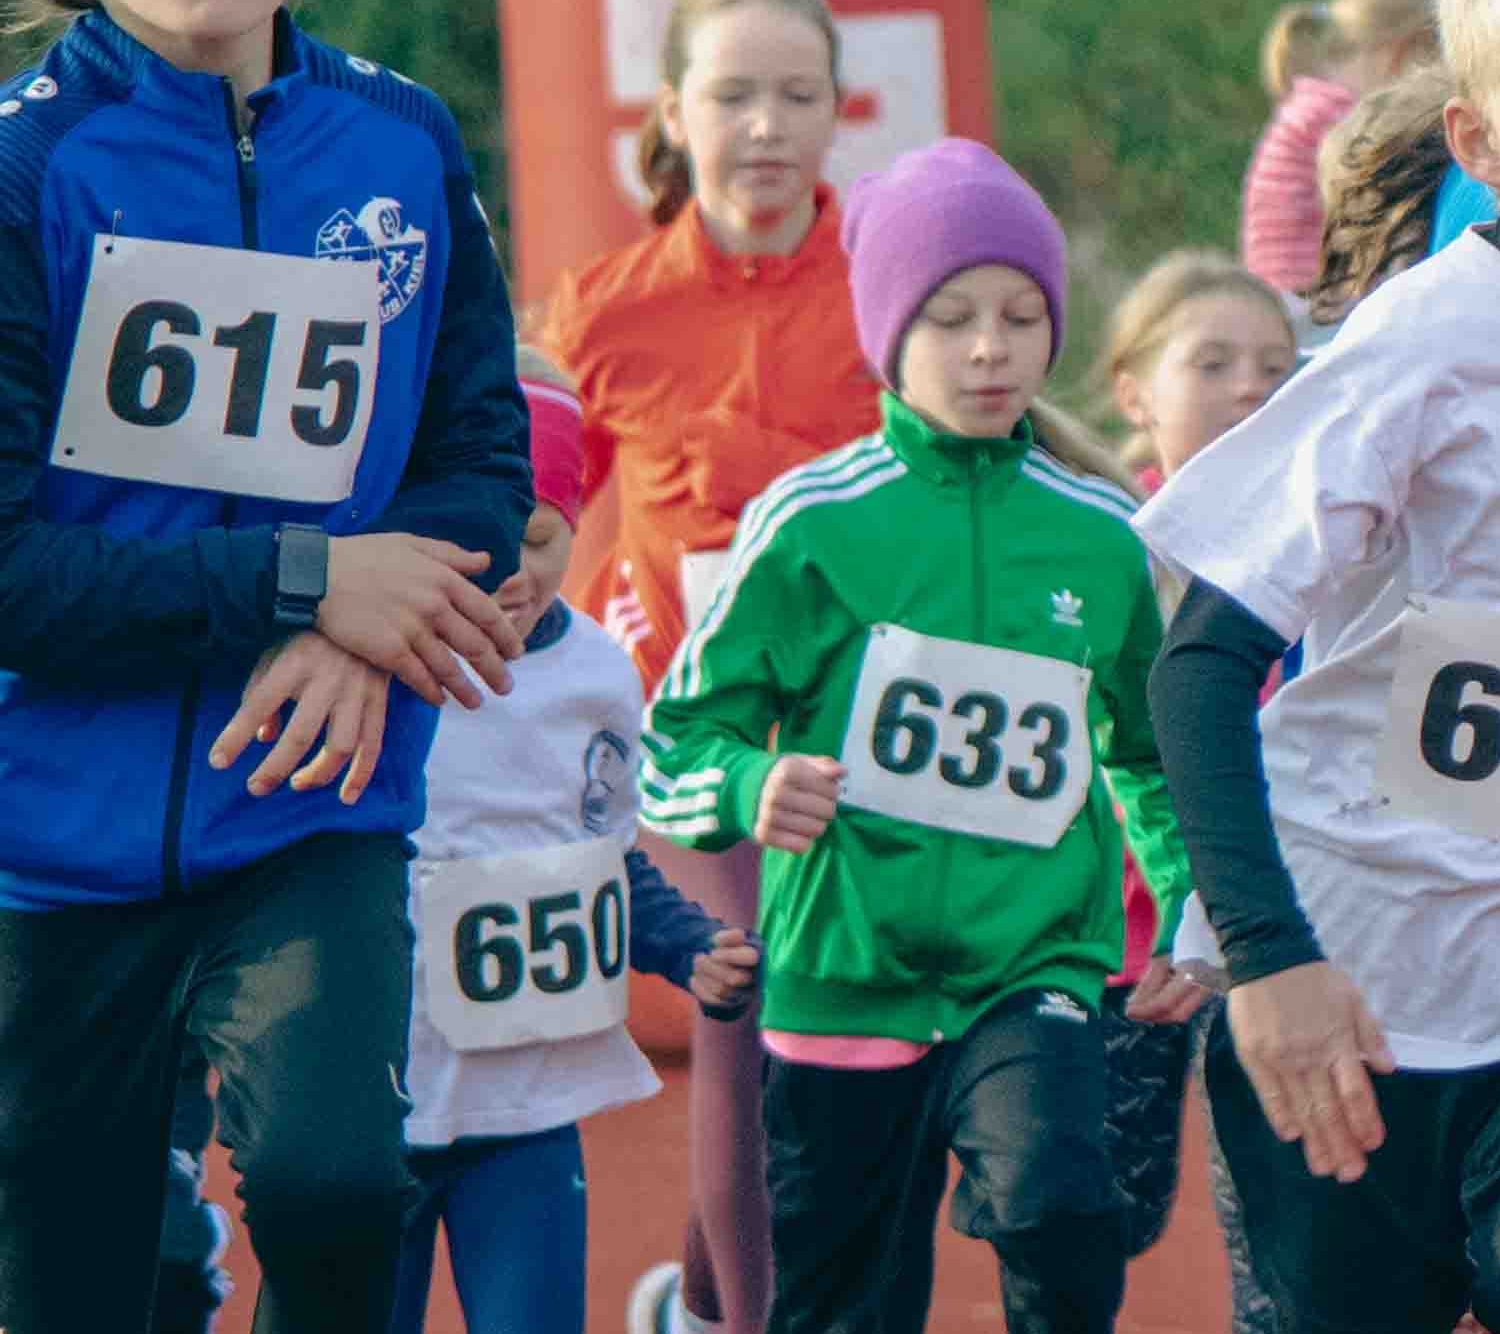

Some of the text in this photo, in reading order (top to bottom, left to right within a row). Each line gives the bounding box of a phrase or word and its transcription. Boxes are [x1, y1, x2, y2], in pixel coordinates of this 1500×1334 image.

[106, 300, 368, 447] 615
[871, 679, 1069, 802] 633
[453, 877, 628, 1003] 650
